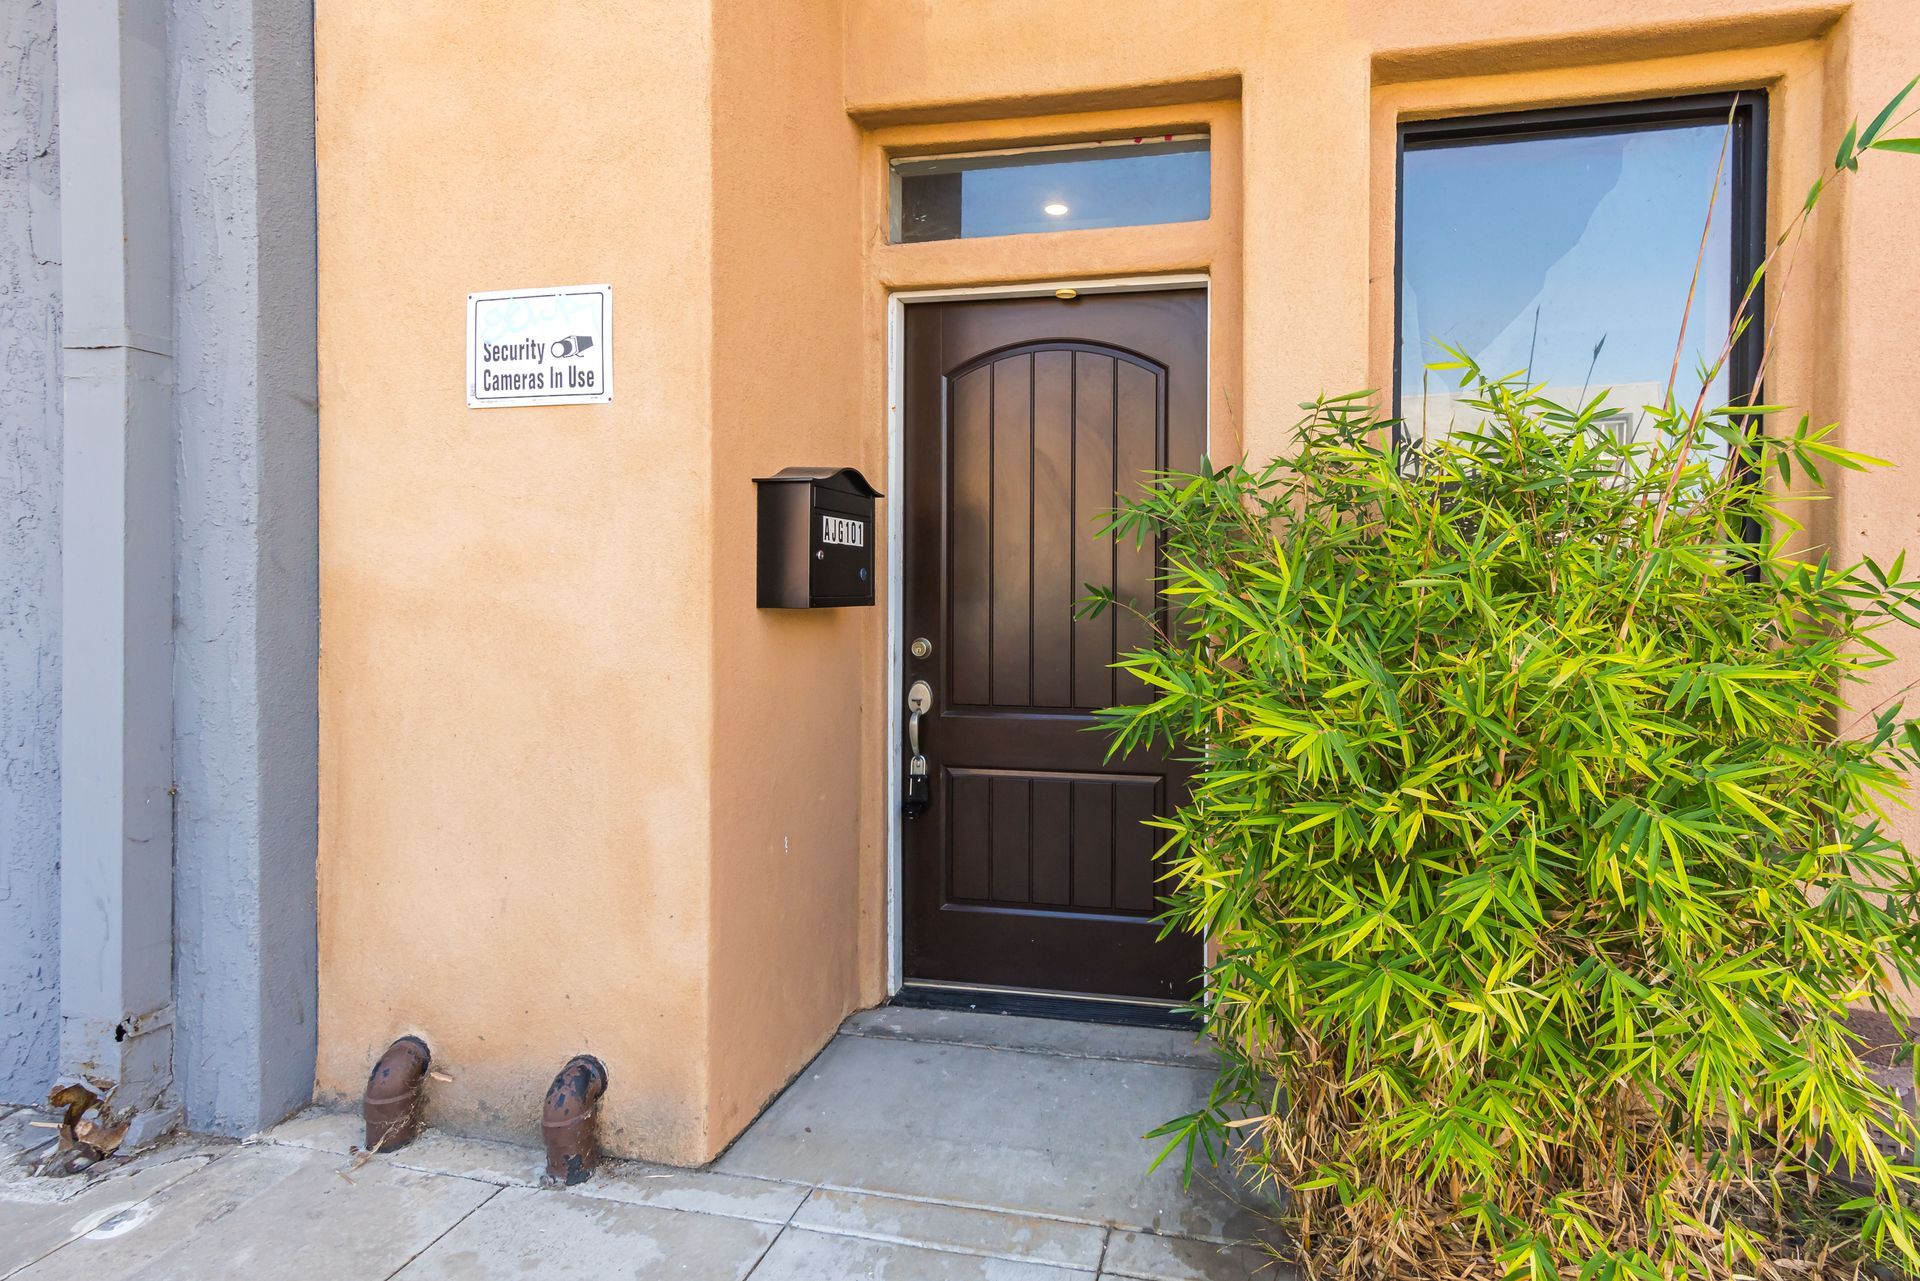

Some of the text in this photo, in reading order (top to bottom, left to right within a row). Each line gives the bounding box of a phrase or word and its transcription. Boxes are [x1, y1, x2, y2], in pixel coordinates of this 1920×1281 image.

[483, 338, 545, 364] Security
[483, 368, 544, 391] Cameras
[549, 366, 563, 388] In
[568, 365, 595, 388] Use
[824, 518, 862, 545] AJG101
